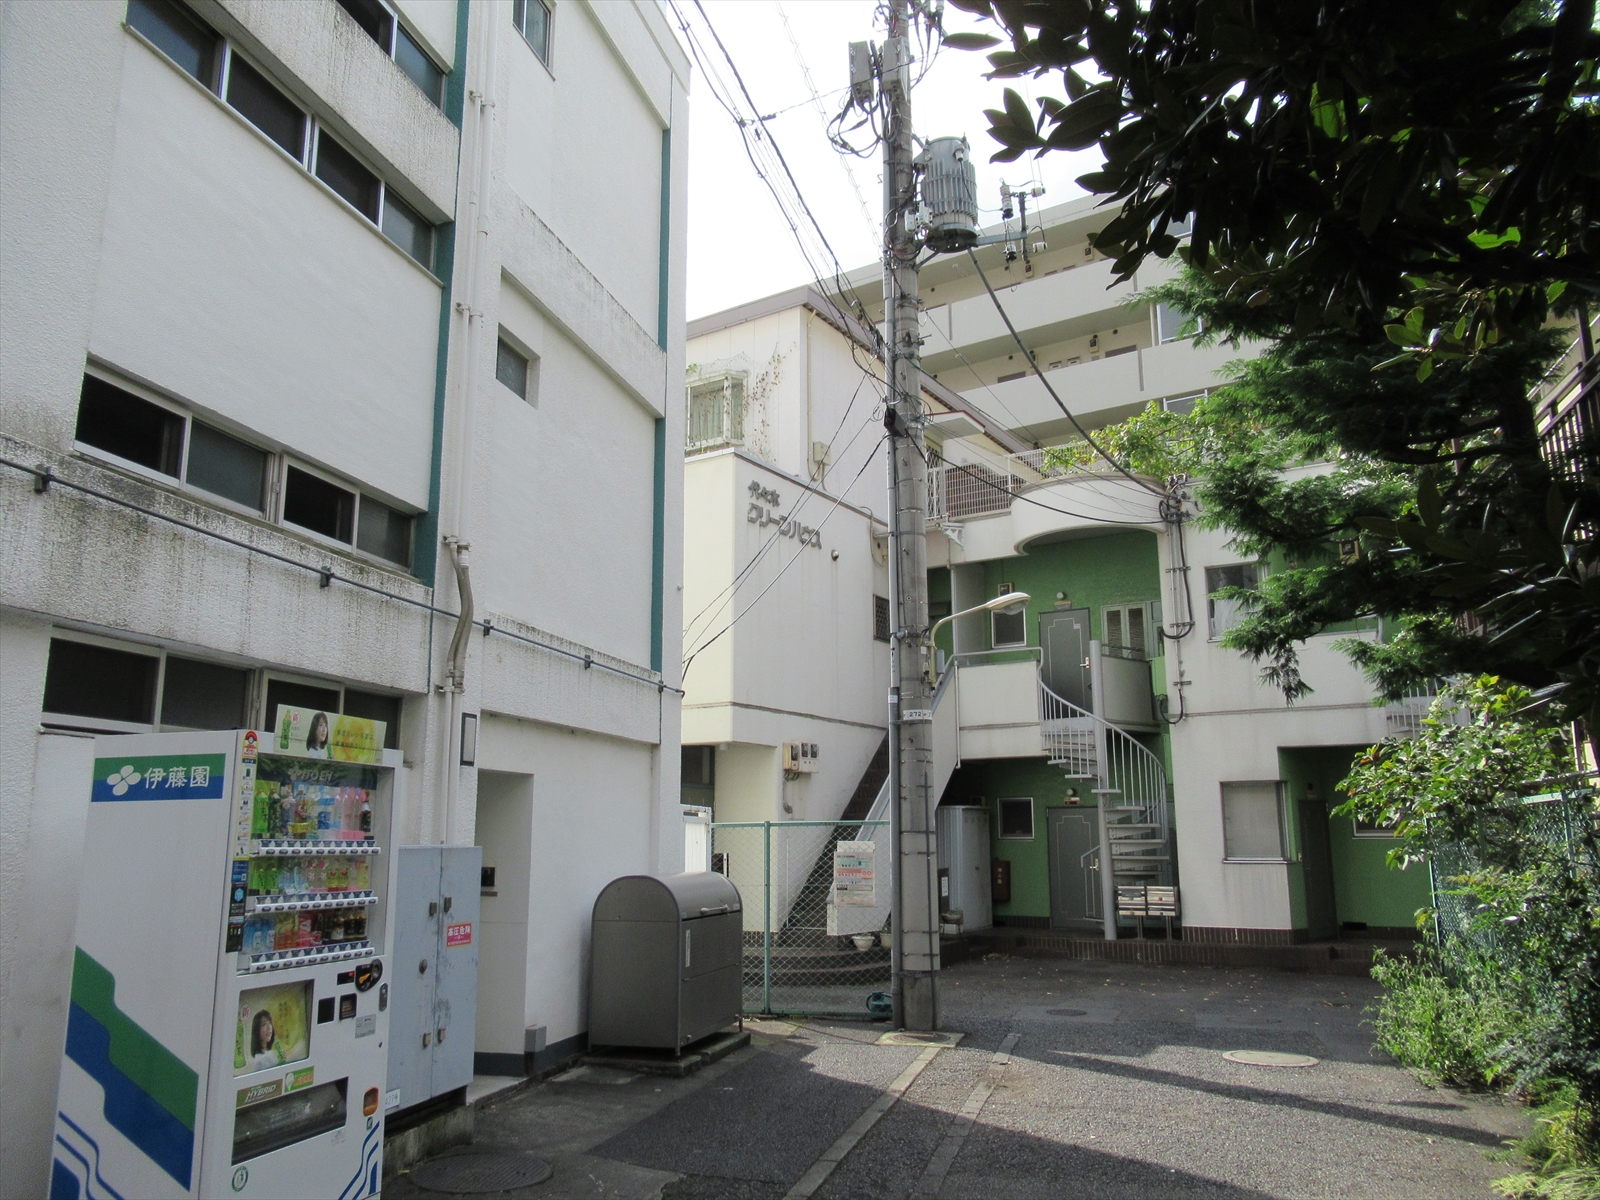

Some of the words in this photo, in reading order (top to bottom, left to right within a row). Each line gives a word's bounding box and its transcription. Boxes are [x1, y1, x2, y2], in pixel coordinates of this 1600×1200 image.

[144, 766, 210, 789] 伊藤園
[245, 1084, 277, 1103] HYBRID
